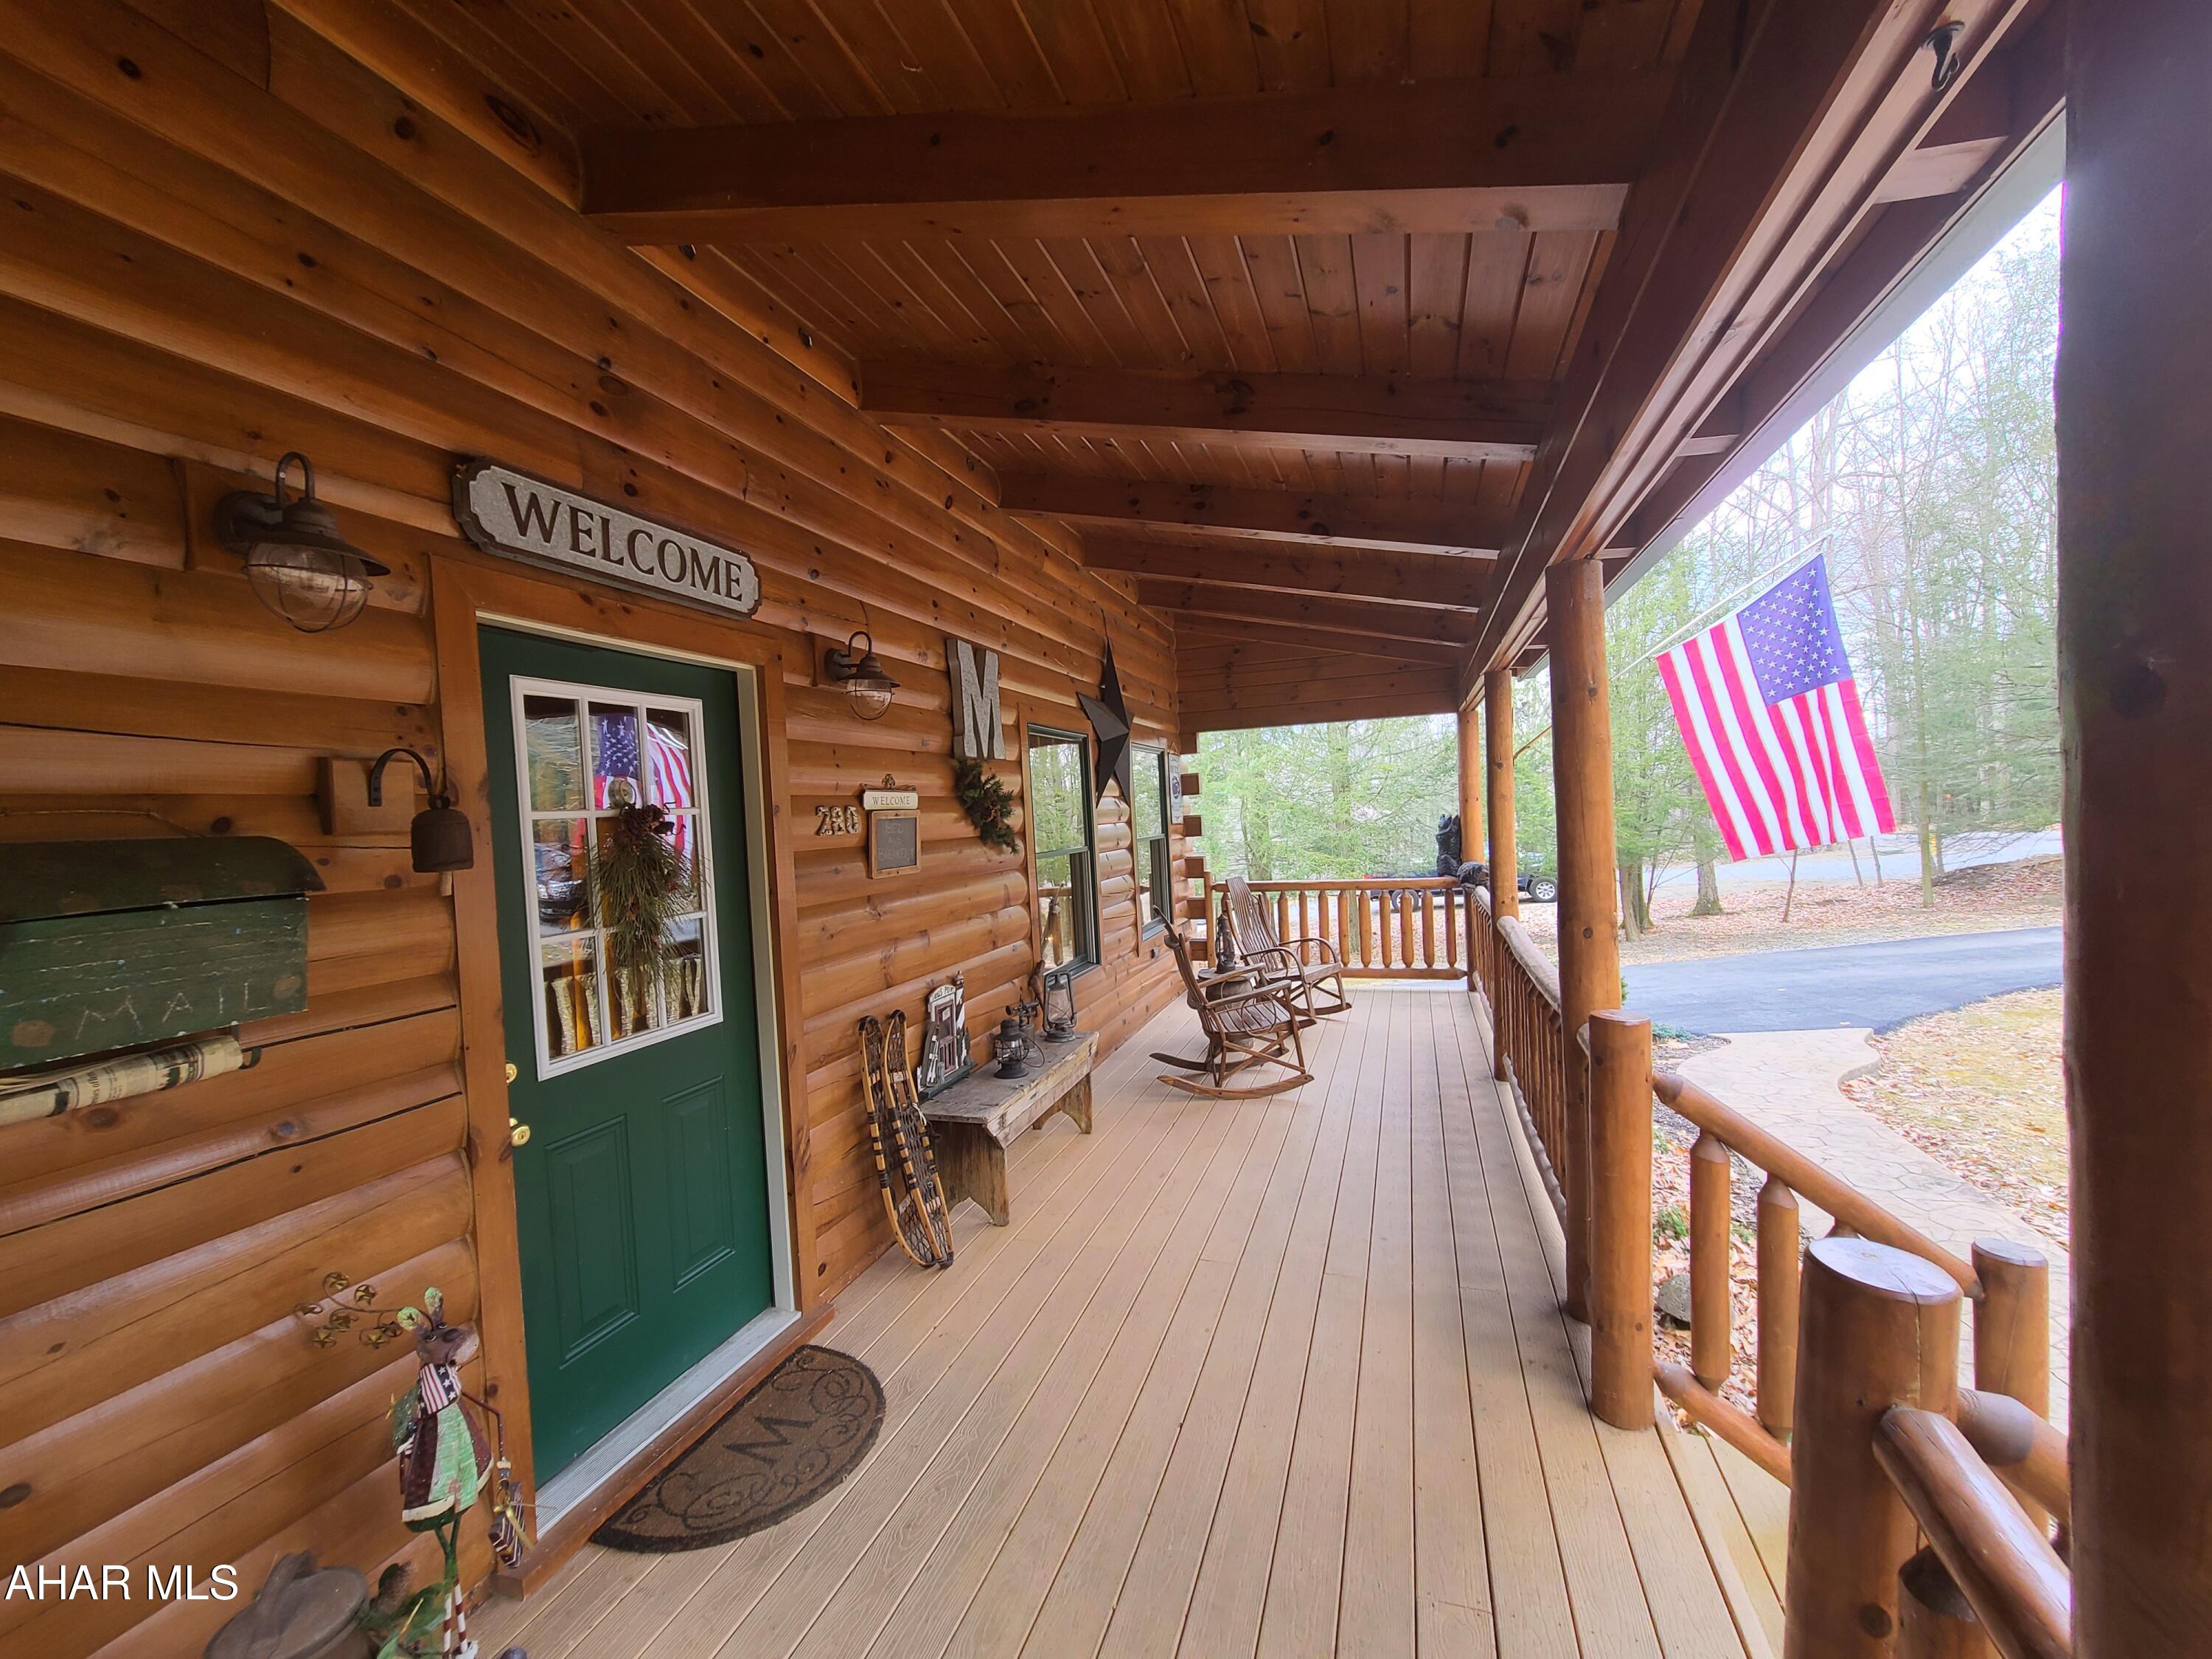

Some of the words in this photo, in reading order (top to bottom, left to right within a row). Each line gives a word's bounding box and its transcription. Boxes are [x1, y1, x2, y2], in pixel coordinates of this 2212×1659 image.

[501, 481, 742, 602] WELCOME
[951, 639, 1006, 759] M
[872, 796, 911, 806] WELCOME
[76, 978, 271, 1040] MAIL
[722, 1416, 813, 1468] M
